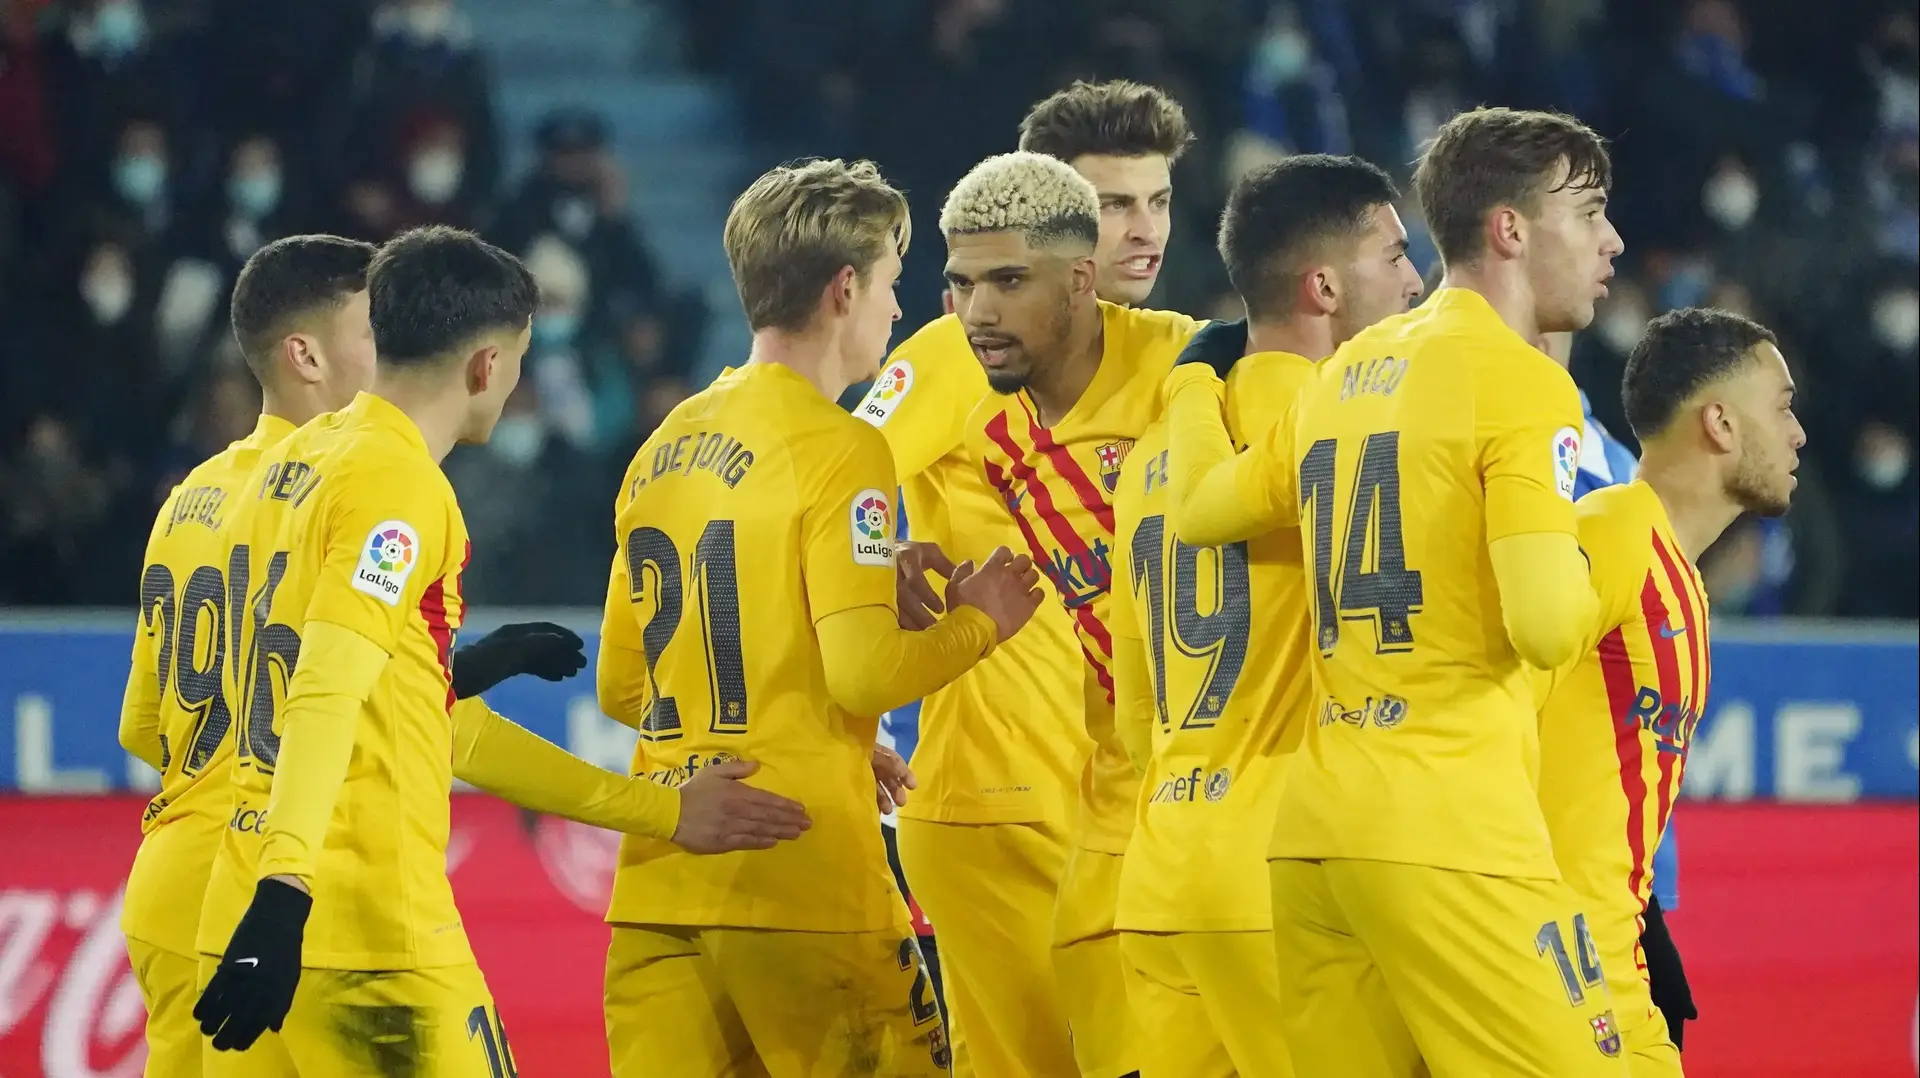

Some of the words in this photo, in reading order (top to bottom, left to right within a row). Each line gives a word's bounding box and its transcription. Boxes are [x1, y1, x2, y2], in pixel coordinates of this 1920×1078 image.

[866, 401, 886, 418] iga
[1341, 356, 1409, 402] NICO
[651, 434, 692, 482] DE
[683, 432, 754, 489] JONG
[858, 543, 893, 560] LaLiga
[1299, 431, 1423, 657] 14
[359, 568, 400, 595] LaLiga
[627, 520, 748, 741] 21
[1130, 515, 1251, 734] 19
[897, 936, 939, 1027] 2
[1534, 912, 1605, 1008] 14
